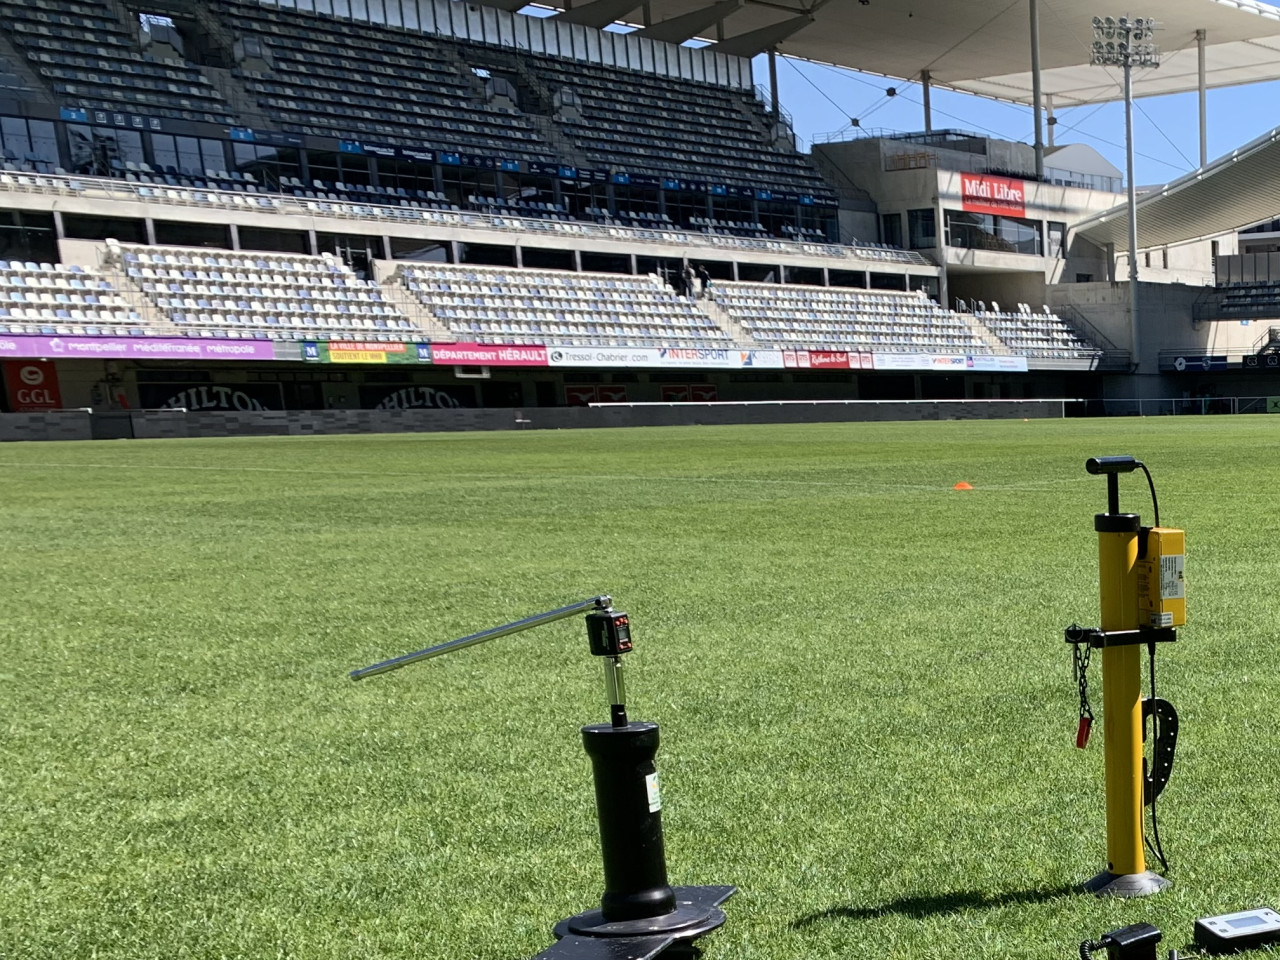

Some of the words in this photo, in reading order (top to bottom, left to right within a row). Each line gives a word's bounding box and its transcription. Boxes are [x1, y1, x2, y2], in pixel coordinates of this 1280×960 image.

[964, 179, 991, 198] Midi
[993, 182, 1022, 202] Libre
[68, 343, 128, 353] Montpellier
[133, 342, 200, 352] Méditerranée
[433, 349, 498, 361] DÉPARTEMENT
[498, 348, 547, 362] HÉRAULT
[668, 349, 729, 361] INTERSPORT
[16, 388, 56, 404] GGL
